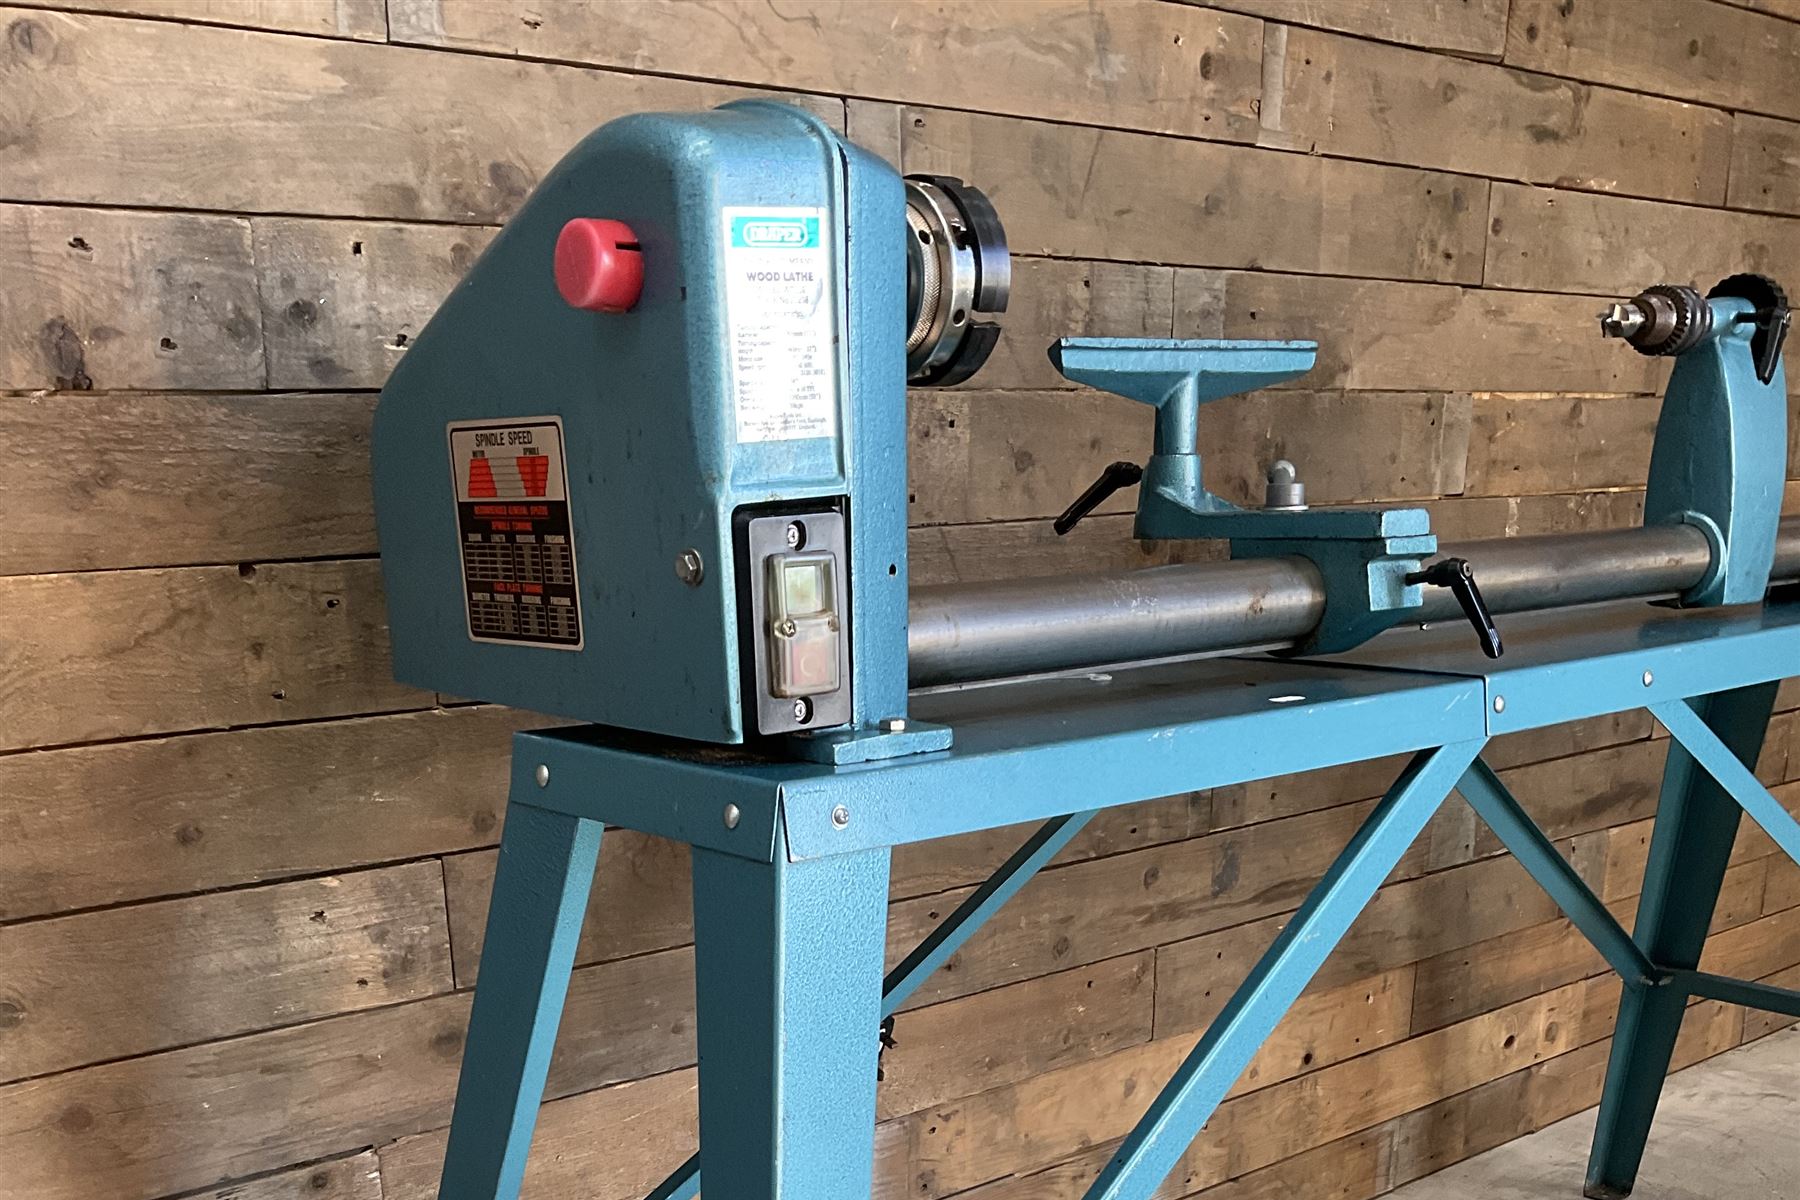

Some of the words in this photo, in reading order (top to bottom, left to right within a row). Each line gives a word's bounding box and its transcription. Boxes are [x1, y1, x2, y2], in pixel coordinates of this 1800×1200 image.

[746, 271, 780, 282] WOOD
[783, 271, 814, 282] LATHE
[475, 432, 505, 447] SPINDLE
[507, 430, 533, 446] SPEED
